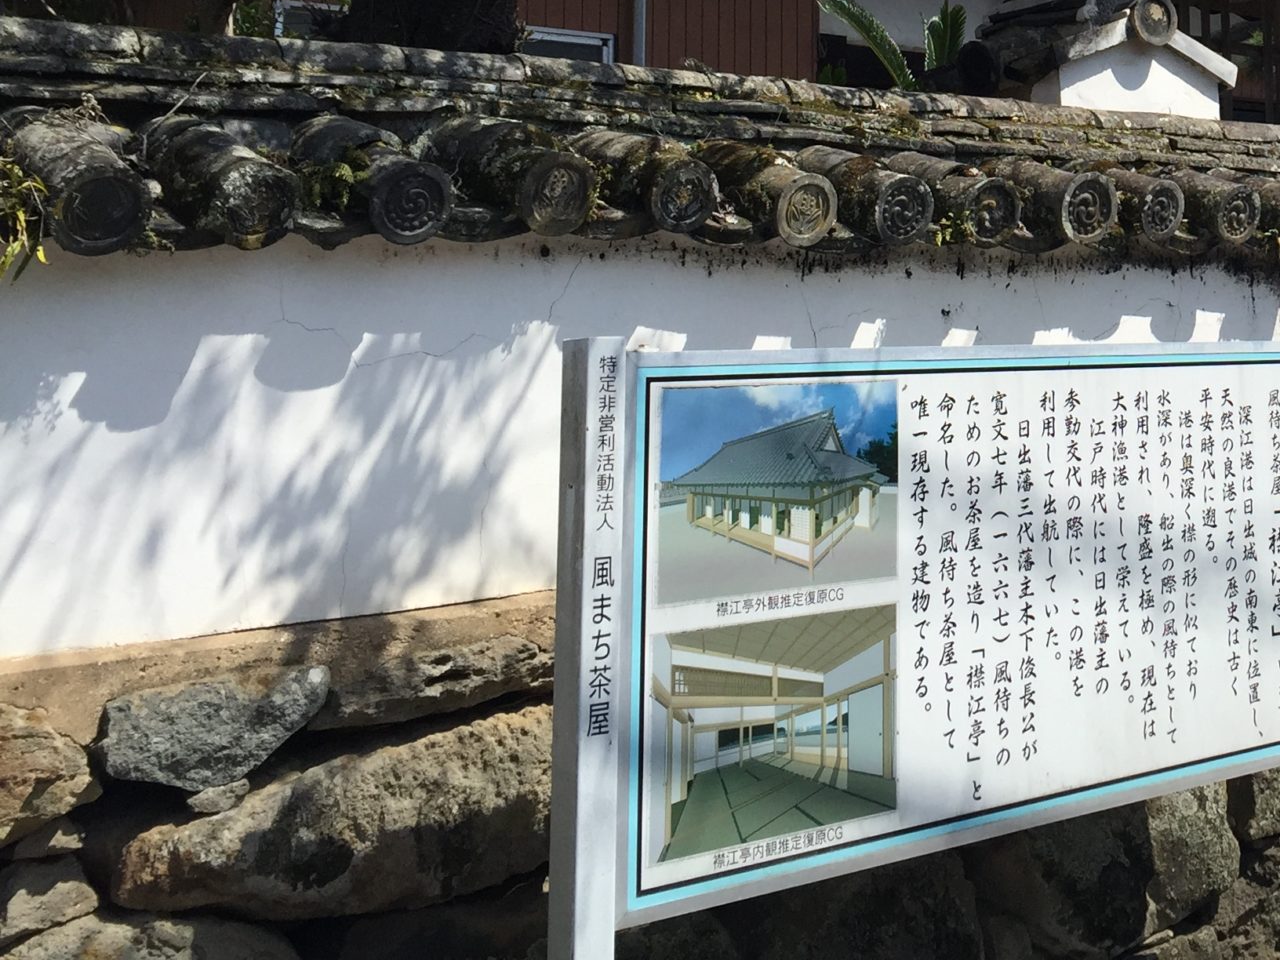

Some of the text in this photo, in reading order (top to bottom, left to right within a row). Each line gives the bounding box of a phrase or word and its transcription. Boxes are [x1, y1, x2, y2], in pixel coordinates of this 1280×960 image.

[587, 355, 617, 737] 特定非営利活動法人 風まち茶屋
[910, 395, 931, 712] 唯一現存する建物である。
[1017, 420, 1038, 761] 日出藩三代藩主木下俊長公が
[1040, 390, 1061, 660] 利用して出航していた。
[1090, 418, 1110, 695] 江戸時代には日出藩主の
[1111, 391, 1134, 704] 大神漁港として栄えている。
[1178, 410, 1198, 701] 港は奥深く襟の形に似ており
[1199, 387, 1218, 564] 平安時代に遡る。
[1220, 387, 1241, 696] 天然の良港でその歴史は古く
